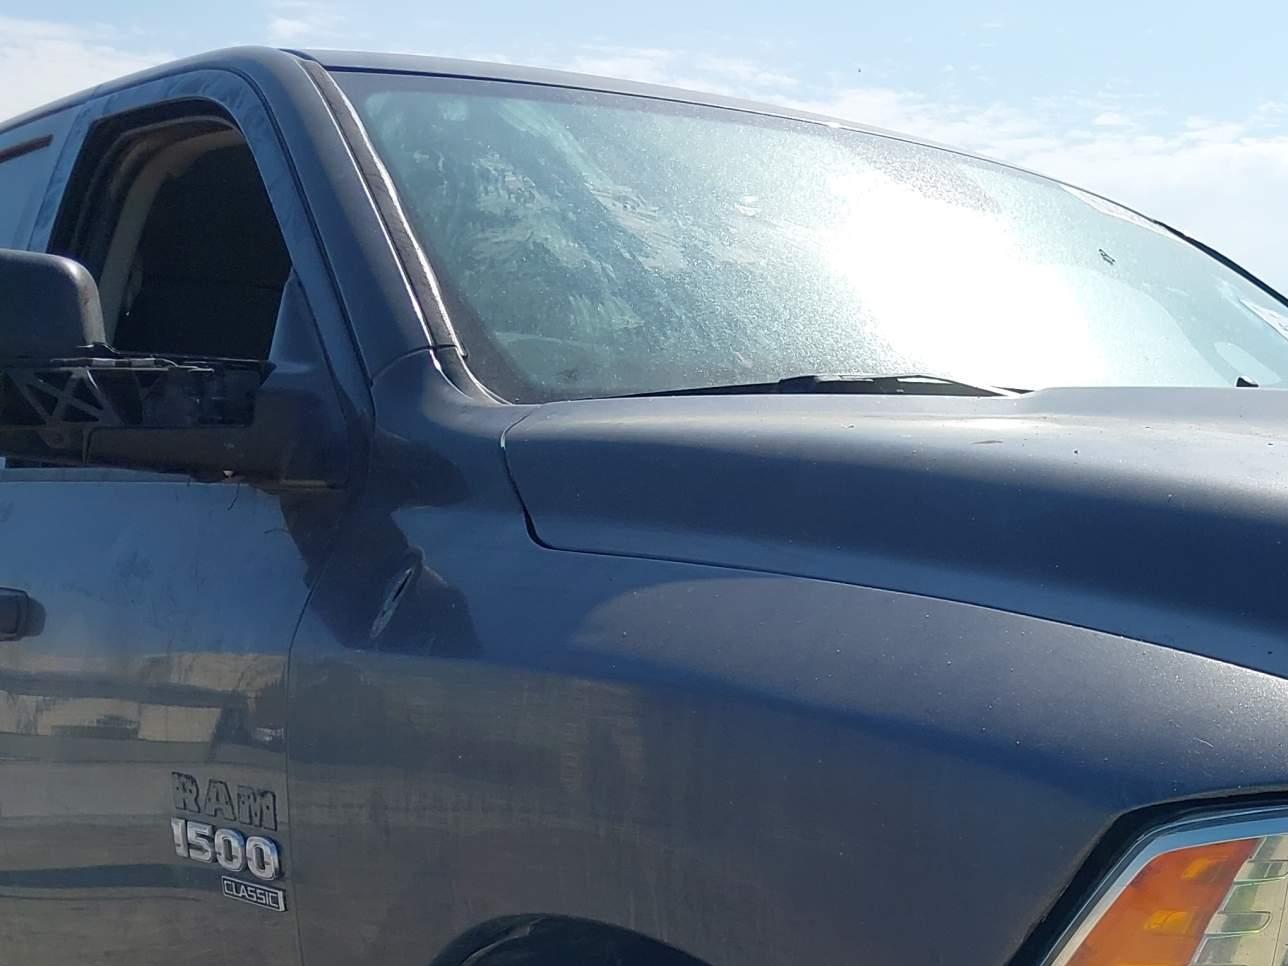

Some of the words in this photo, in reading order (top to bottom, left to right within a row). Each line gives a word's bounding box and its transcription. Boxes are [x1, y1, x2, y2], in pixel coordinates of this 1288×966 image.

[171, 771, 278, 831] RAM
[170, 817, 283, 881] 1500
[222, 878, 281, 909] CLASSIC
